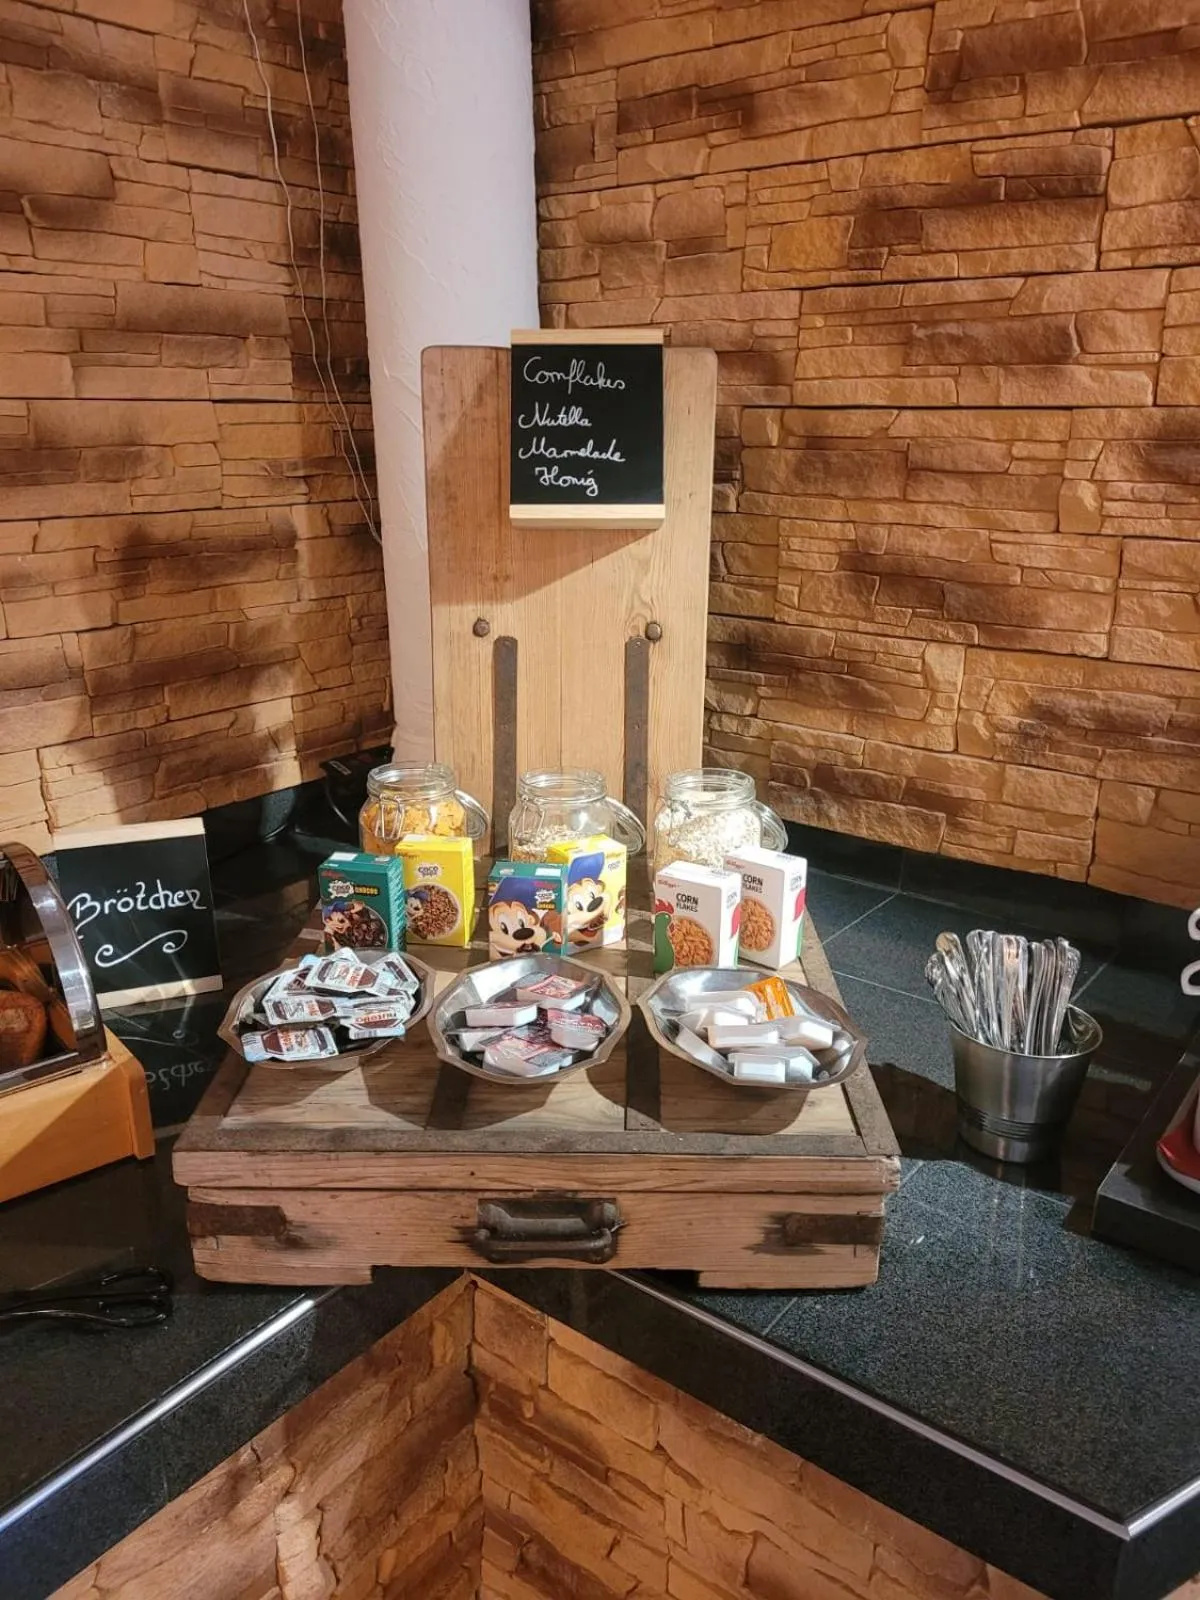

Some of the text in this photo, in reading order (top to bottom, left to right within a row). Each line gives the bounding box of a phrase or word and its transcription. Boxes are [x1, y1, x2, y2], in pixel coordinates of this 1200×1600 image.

[518, 402, 592, 429] Nutella
[535, 465, 599, 497] Honig
[743, 873, 764, 886] CORN
[67, 878, 208, 931] Brötchen
[676, 893, 699, 906] CORN
[676, 902, 699, 913] FLAKES
